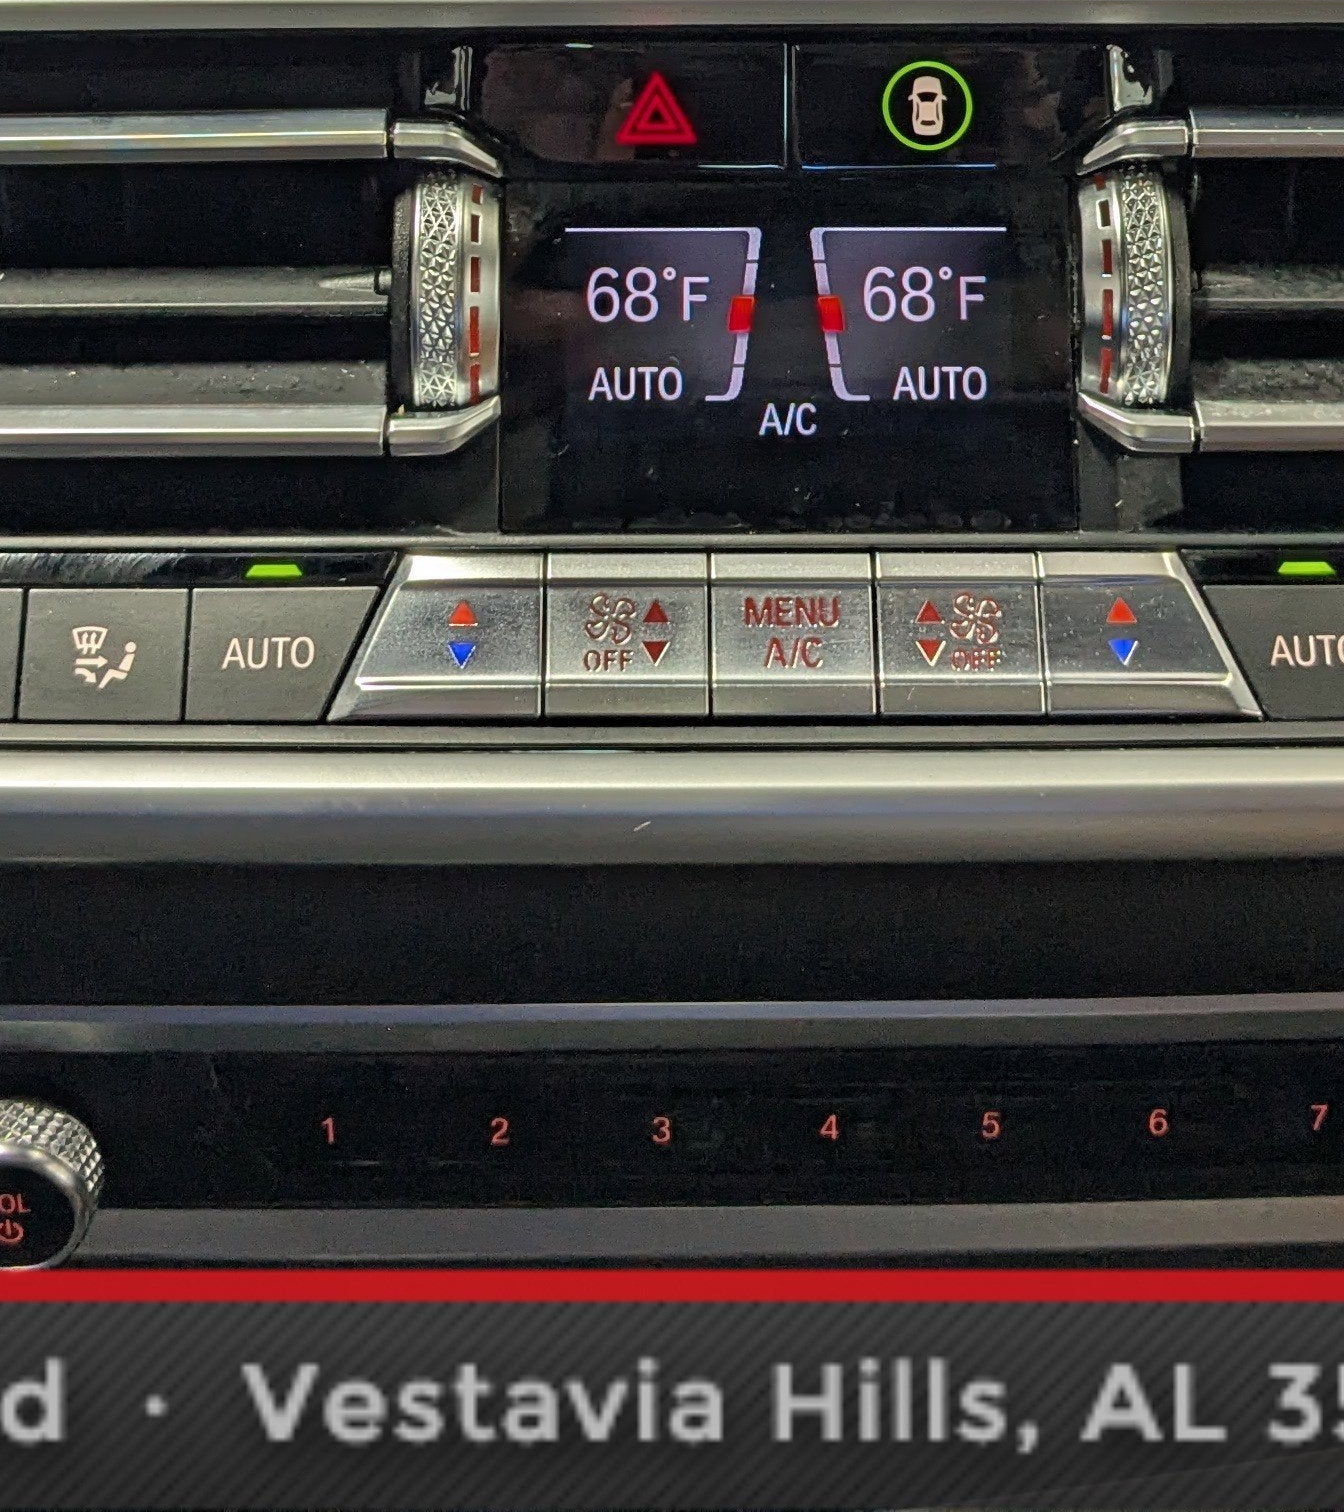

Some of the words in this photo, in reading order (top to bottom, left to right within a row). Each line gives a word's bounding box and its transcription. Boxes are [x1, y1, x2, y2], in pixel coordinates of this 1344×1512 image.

[587, 265, 711, 324] 68°F
[862, 265, 987, 324] 68°F
[587, 365, 684, 402] AUTO
[892, 365, 988, 402] AUTO
[758, 401, 819, 437] A/C
[742, 596, 841, 629] MENU
[220, 635, 316, 671] AUTO
[582, 648, 633, 672] OFF
[763, 636, 823, 669] A/C
[950, 646, 1002, 672] OFF
[321, 1116, 338, 1144] 1
[489, 1116, 511, 1146] 2
[650, 1115, 673, 1146] 3
[819, 1113, 840, 1141] 4
[980, 1110, 1003, 1140] 5
[1146, 1107, 1170, 1137] 6
[1311, 1102, 1330, 1131] 7
